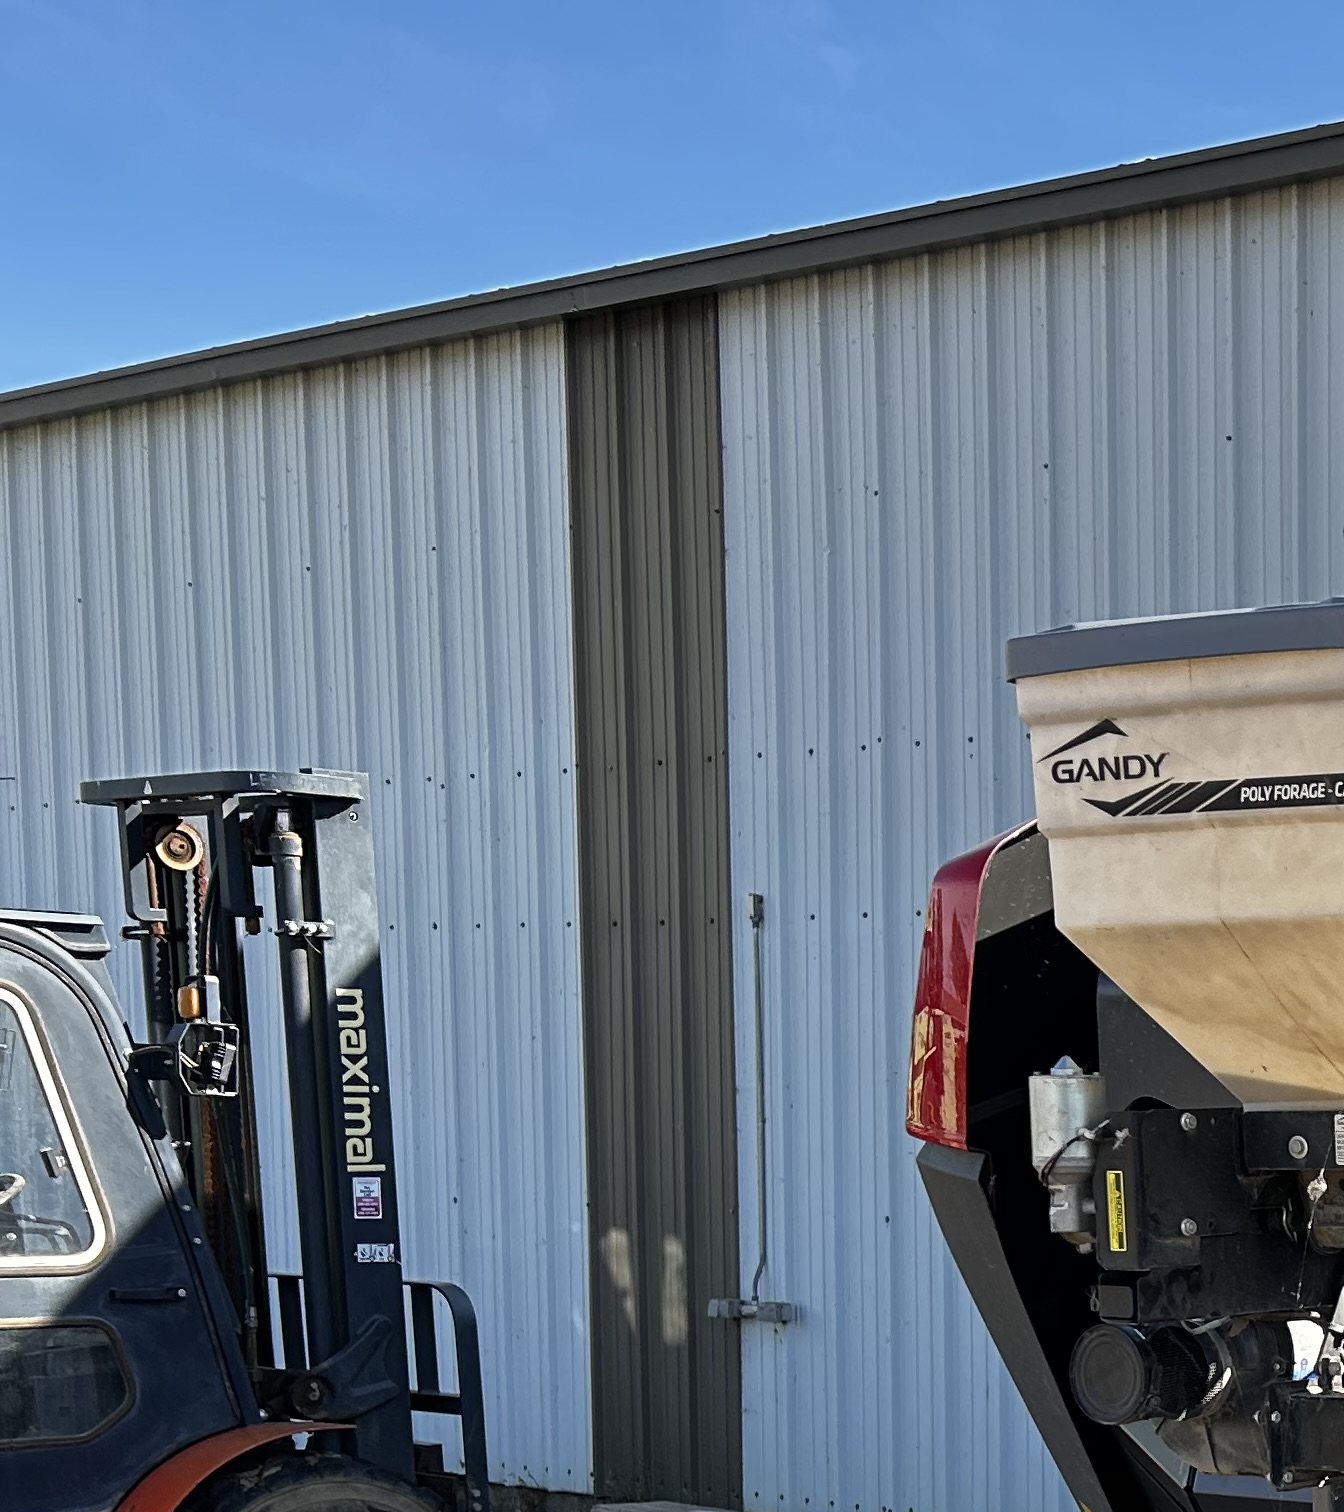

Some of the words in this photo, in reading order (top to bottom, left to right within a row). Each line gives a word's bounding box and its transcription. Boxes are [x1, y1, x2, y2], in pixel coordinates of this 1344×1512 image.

[1051, 751, 1171, 784] GANDY
[1240, 785, 1273, 803] POLY
[1273, 782, 1326, 801] FORAGE
[335, 987, 387, 1173] maximal
